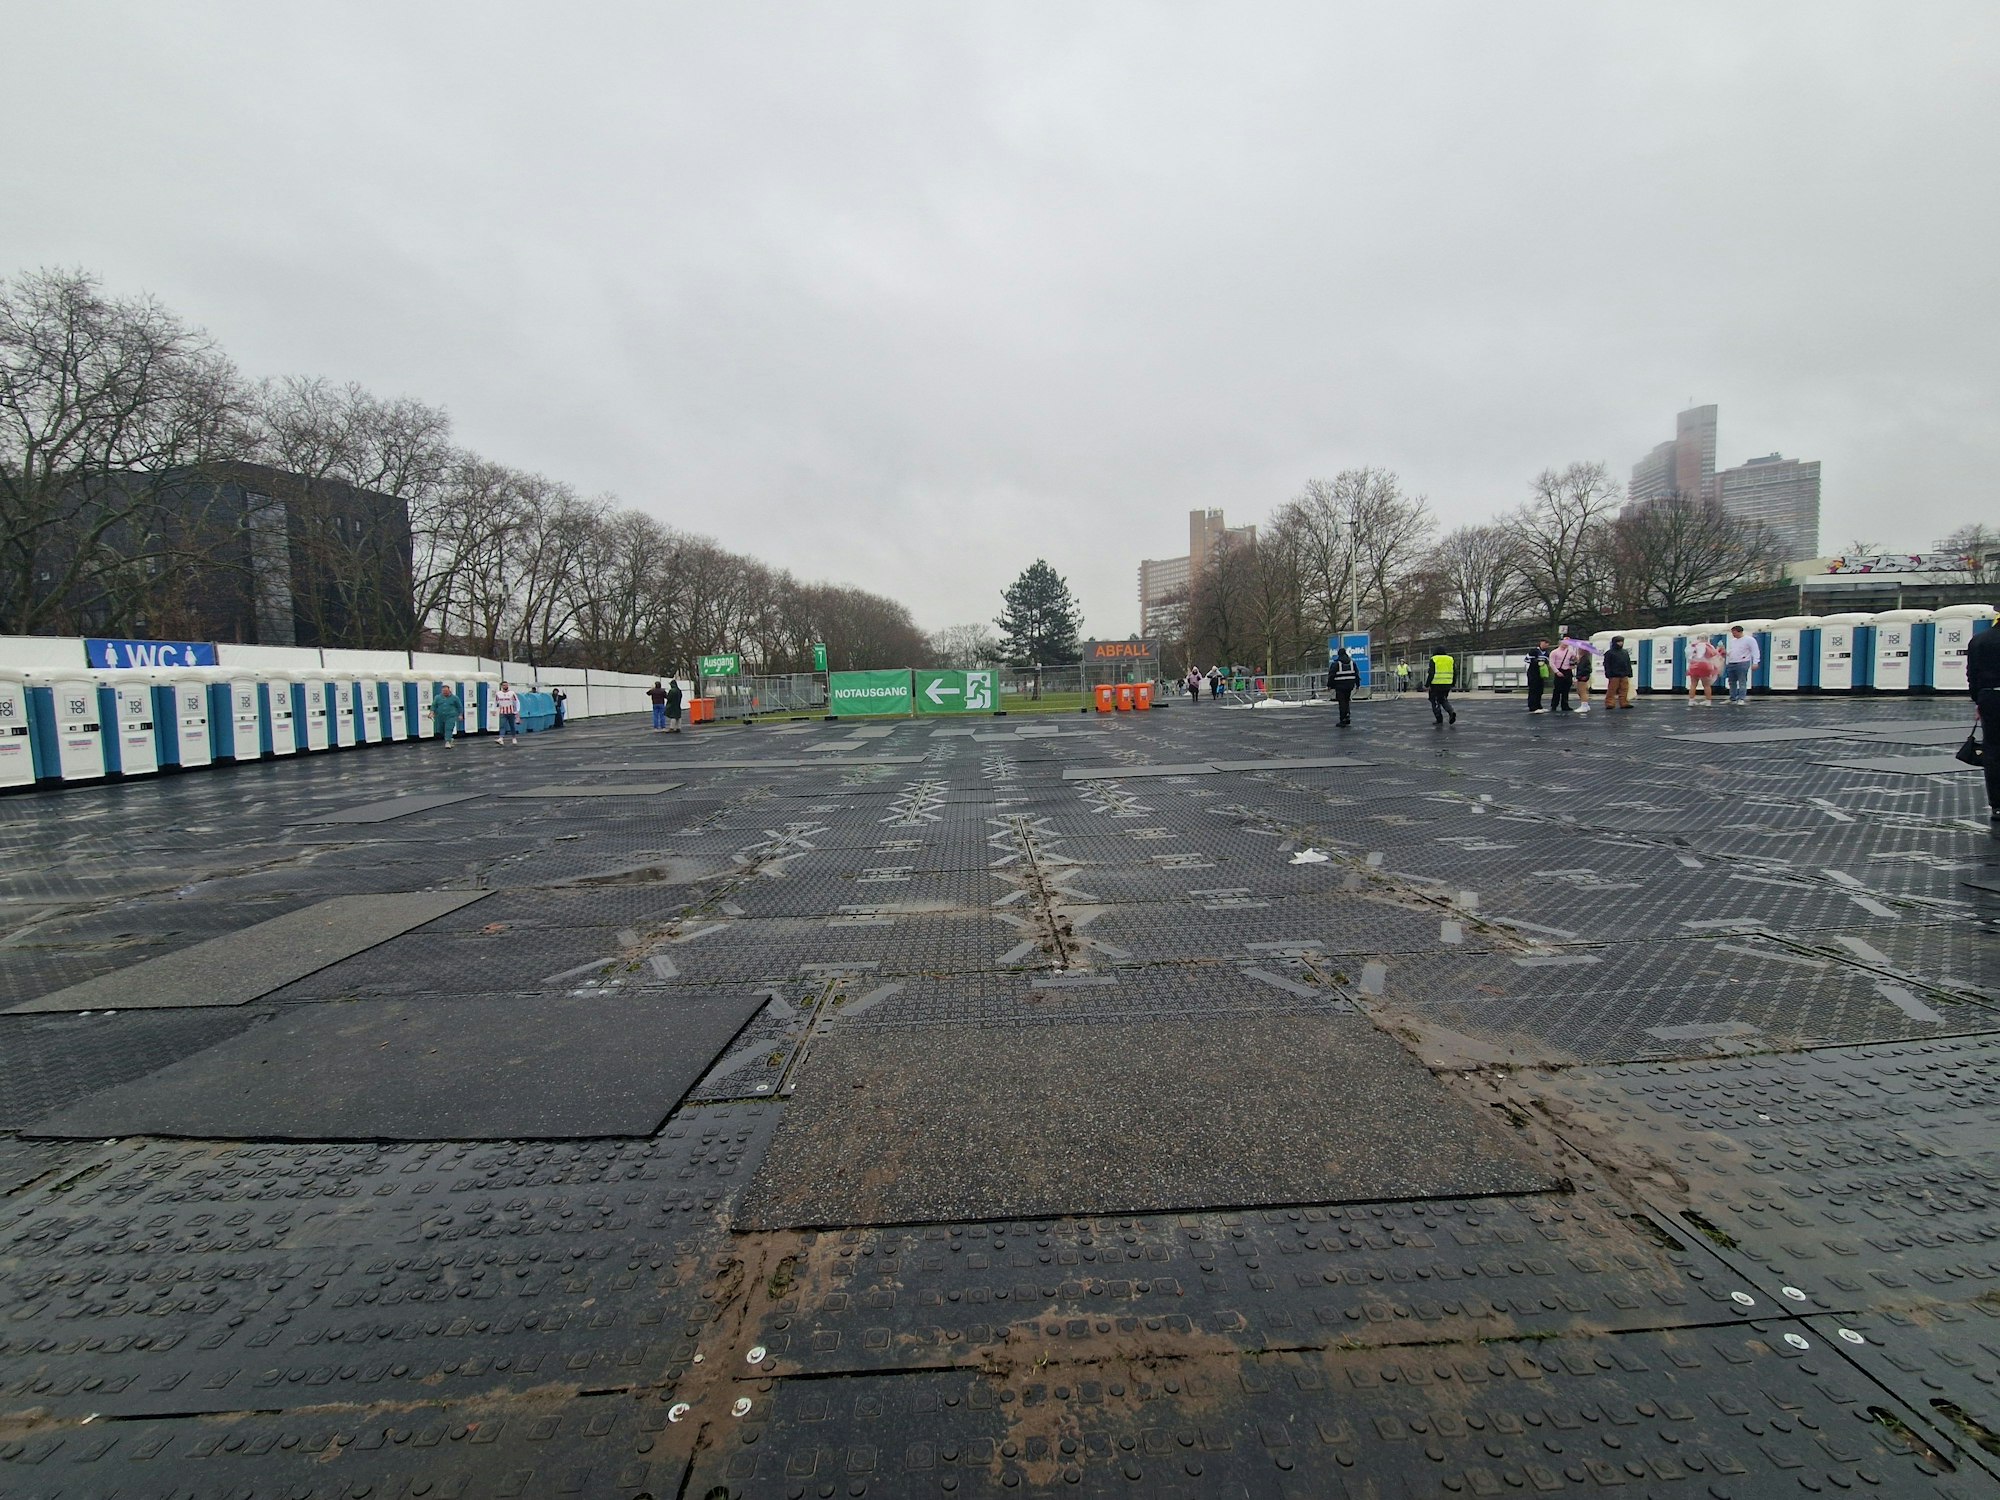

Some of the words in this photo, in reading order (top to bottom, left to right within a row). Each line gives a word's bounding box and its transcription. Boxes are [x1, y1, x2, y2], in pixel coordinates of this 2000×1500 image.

[125, 644, 179, 668] WC
[1095, 643, 1150, 657] ABFALL
[703, 657, 734, 672] Ausgang
[835, 686, 907, 698] NOTAUSGANG
